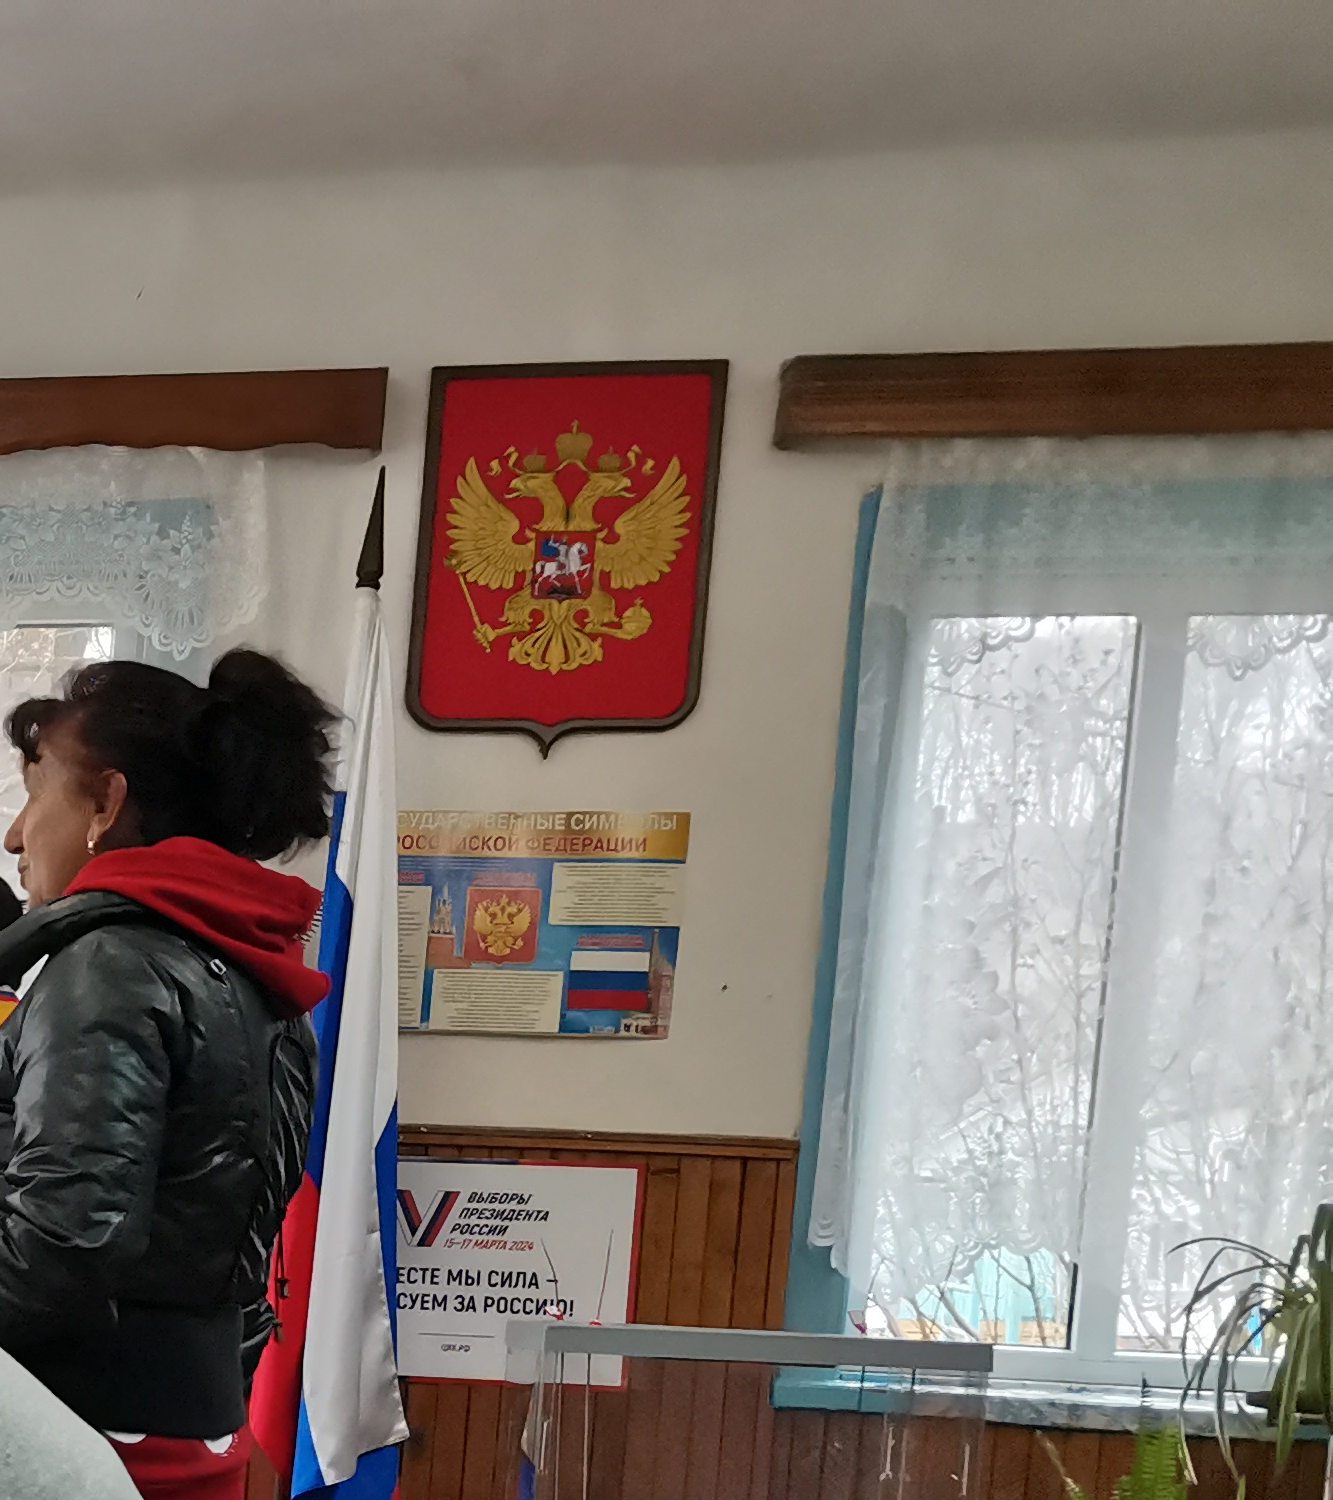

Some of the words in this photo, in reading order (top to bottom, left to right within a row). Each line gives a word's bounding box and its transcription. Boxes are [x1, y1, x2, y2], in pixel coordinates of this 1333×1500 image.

[570, 812, 677, 831] СИМЛЫ
[524, 836, 647, 853] ФЕДЕРАЦИИ
[467, 1191, 534, 1205] ВЫБОРЫ
[458, 1208, 549, 1222] ПРЕЗИДЕНТА
[450, 1223, 509, 1236] РОССИИ
[472, 1239, 507, 1250] МАРТА
[446, 1269, 481, 1286] МЫ
[487, 1270, 539, 1289] СИЛА
[396, 1292, 447, 1312] СУЕМ
[453, 1294, 477, 1313] ЗА
